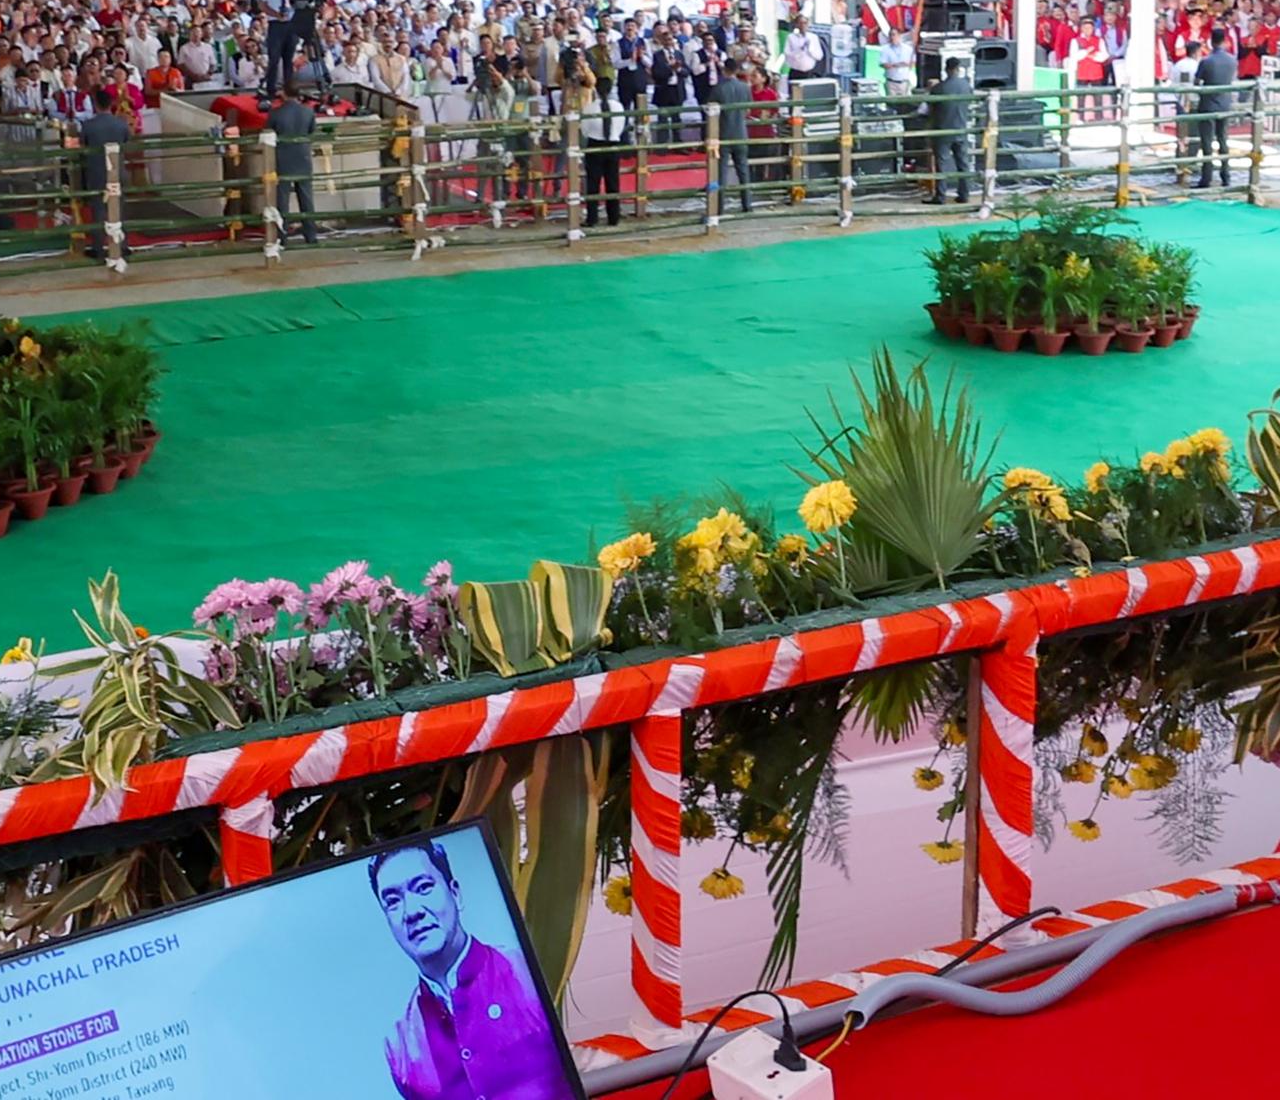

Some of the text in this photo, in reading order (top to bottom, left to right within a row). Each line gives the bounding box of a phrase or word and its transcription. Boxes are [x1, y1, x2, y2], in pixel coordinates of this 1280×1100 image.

[92, 934, 180, 974] PRADESH
[41, 1024, 86, 1051] STONE
[85, 1015, 114, 1038] FOR
[86, 1040, 132, 1067] District
[80, 1065, 127, 1092] District
[125, 1075, 175, 1100] Tawang
